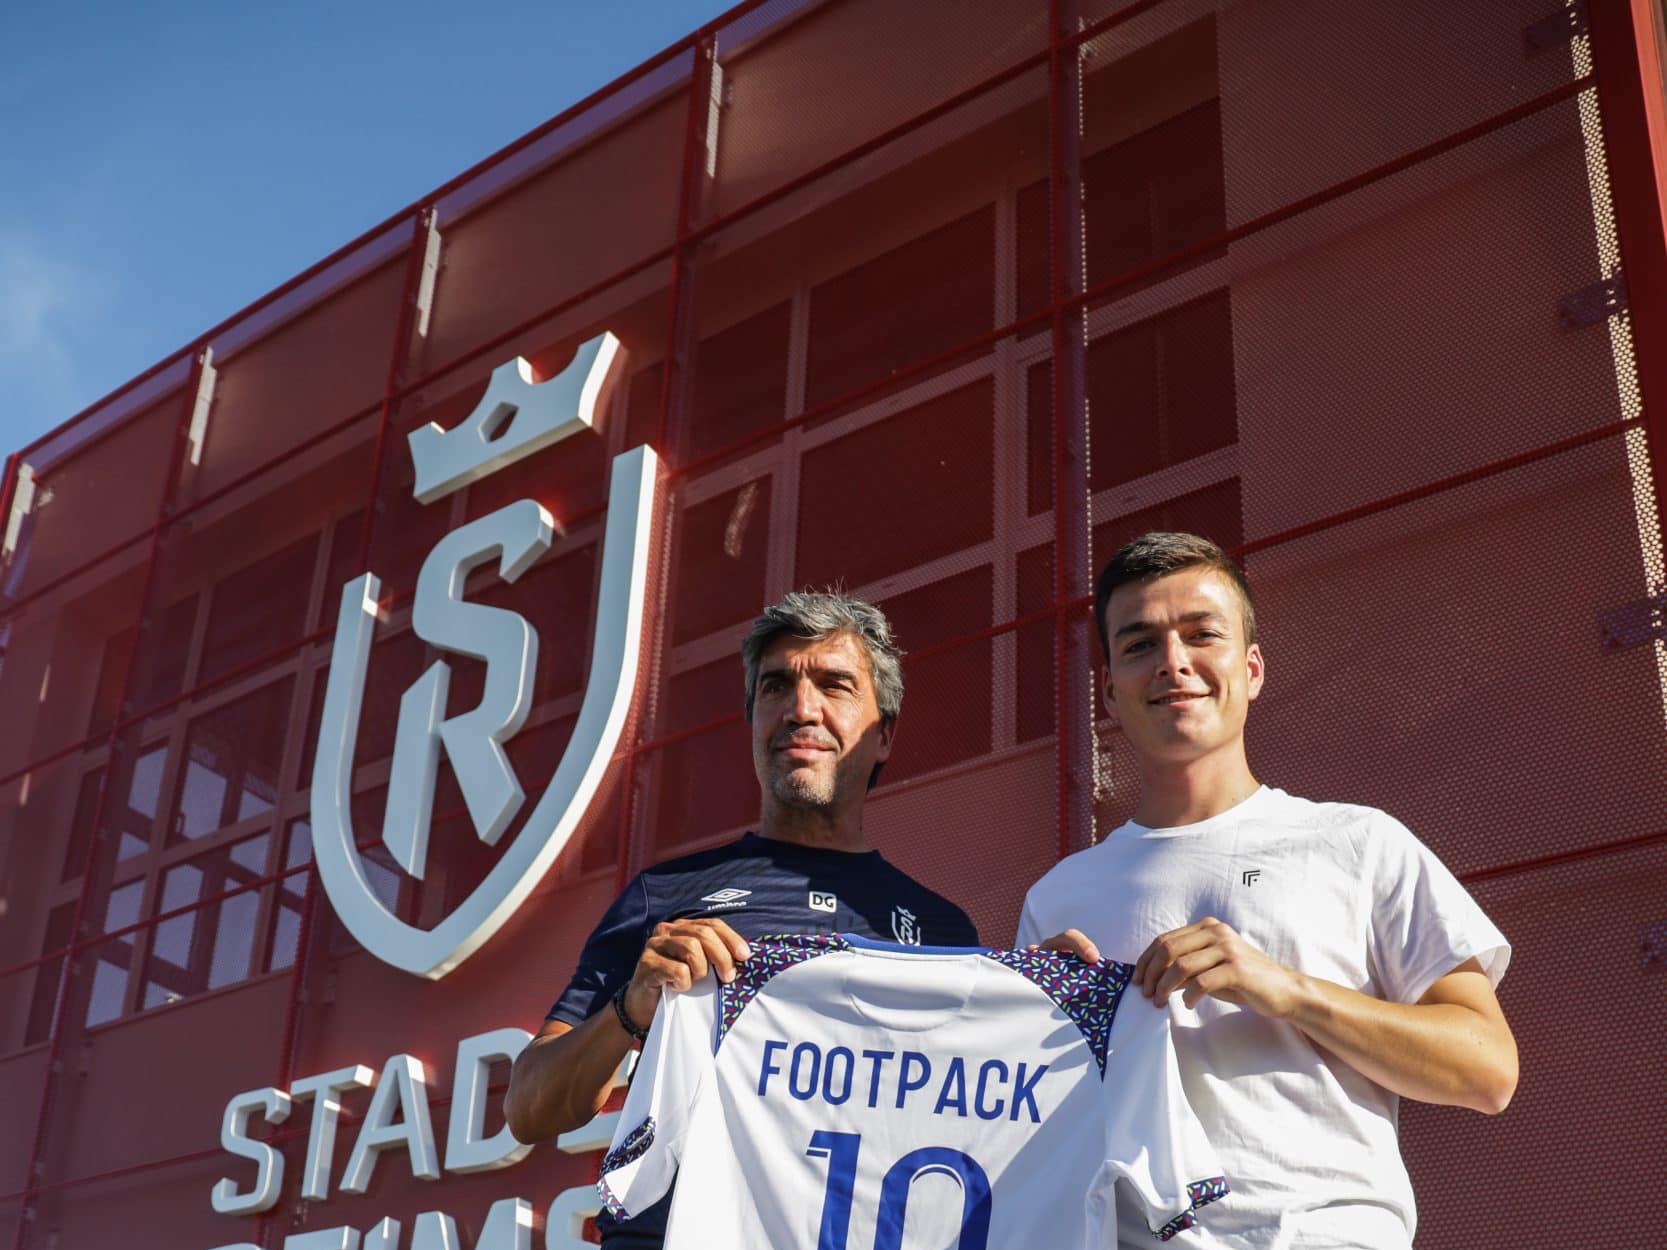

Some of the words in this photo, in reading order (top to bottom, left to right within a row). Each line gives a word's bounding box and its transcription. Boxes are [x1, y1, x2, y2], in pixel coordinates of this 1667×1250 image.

[812, 894, 834, 908] DG
[211, 1027, 640, 1214] STAD
[757, 1039, 1049, 1123] FOOTPACK
